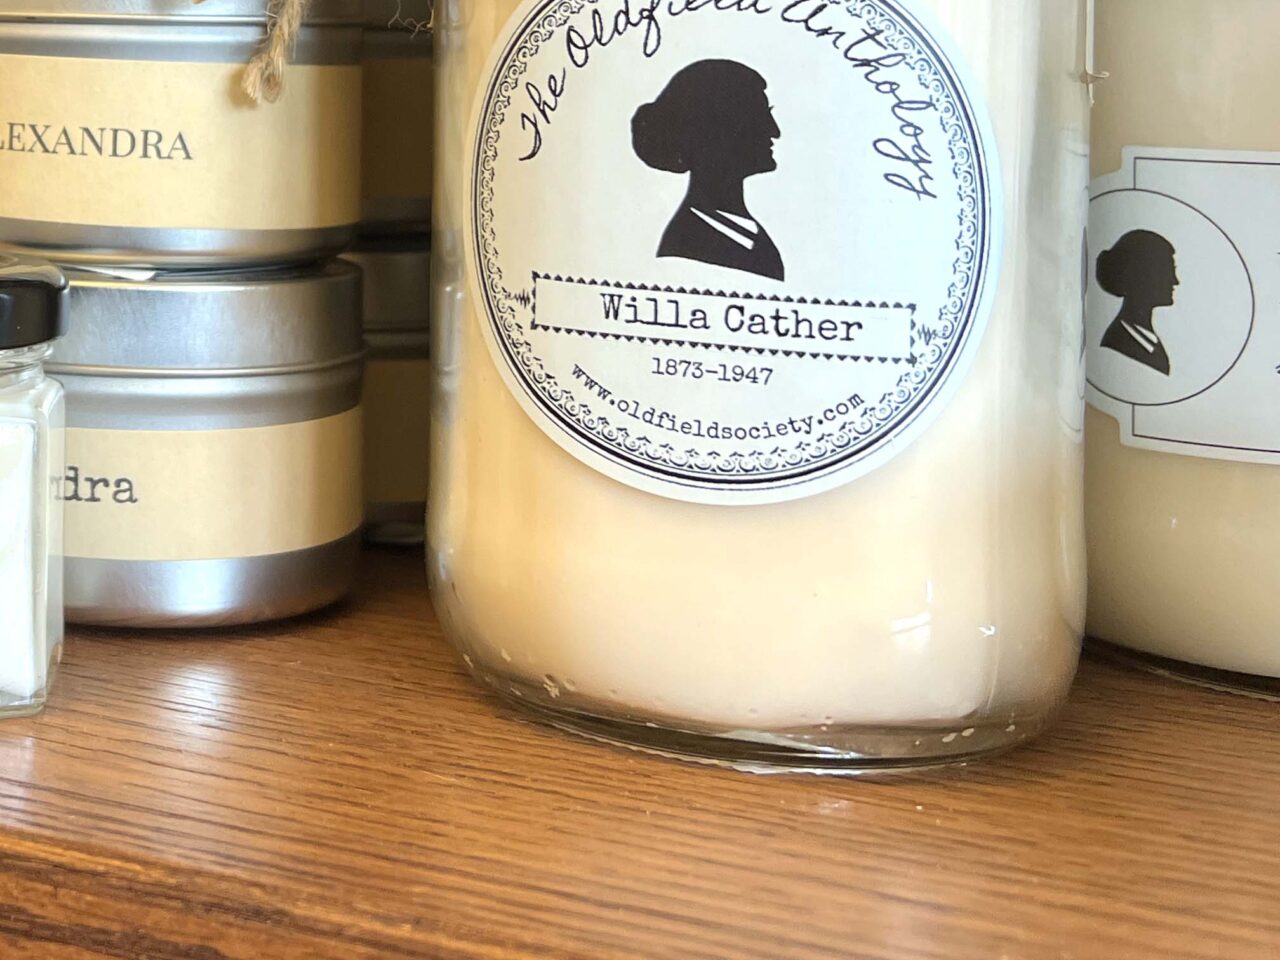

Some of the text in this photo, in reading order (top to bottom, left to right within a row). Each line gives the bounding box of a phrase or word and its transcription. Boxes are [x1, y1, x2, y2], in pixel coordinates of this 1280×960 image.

[519, 67, 567, 161] The
[600, 292, 864, 341] Willa Cather
[572, 362, 865, 442] www.oldfieldsociety.com
[651, 356, 774, 386] 1873-1947
